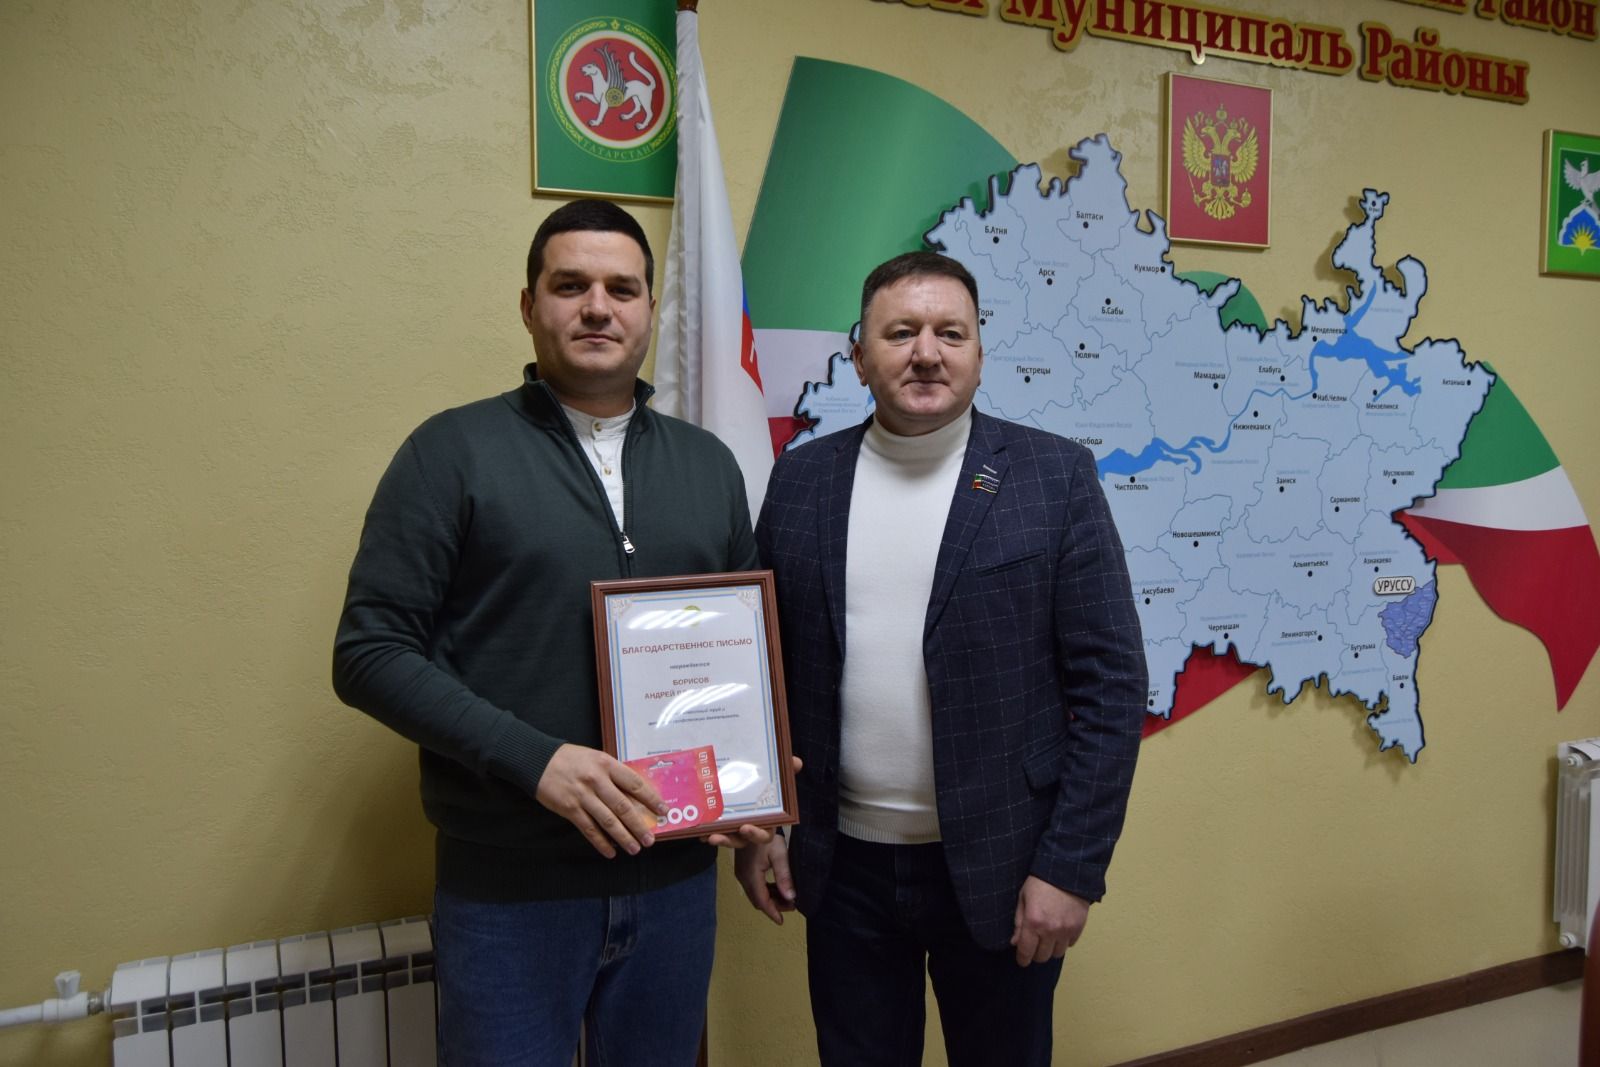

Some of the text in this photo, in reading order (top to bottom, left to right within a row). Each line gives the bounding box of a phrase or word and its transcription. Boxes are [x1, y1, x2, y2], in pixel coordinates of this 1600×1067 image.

[1481, 0, 1598, 36] айон
[1365, 27, 1528, 99] Районы
[582, 141, 652, 160] ТАТАРСТАН
[1076, 211, 1104, 221] Балтаси
[1038, 268, 1056, 277] Арск
[1134, 264, 1160, 274] Кукмор
[1101, 306, 1124, 315] Б.Сабы
[1075, 351, 1100, 360] Тюлячи
[1016, 365, 1051, 375] Пестрецы
[1259, 365, 1282, 374] Елабуга
[1194, 372, 1226, 380] Мамадыш
[1233, 423, 1271, 431] Нижнекамск
[1114, 483, 1149, 492] Чистополь
[1377, 579, 1413, 592] УРУССУ
[1142, 587, 1175, 596] Аксубаево
[1208, 623, 1240, 632] Черемшан
[621, 638, 753, 655] БЛАГОДАРСТВЕННОЕ ПИСЬМО
[1350, 644, 1376, 652] Бугульма
[672, 677, 710, 686] БОРИСОВ
[644, 690, 676, 700] АНДРЕЙ
